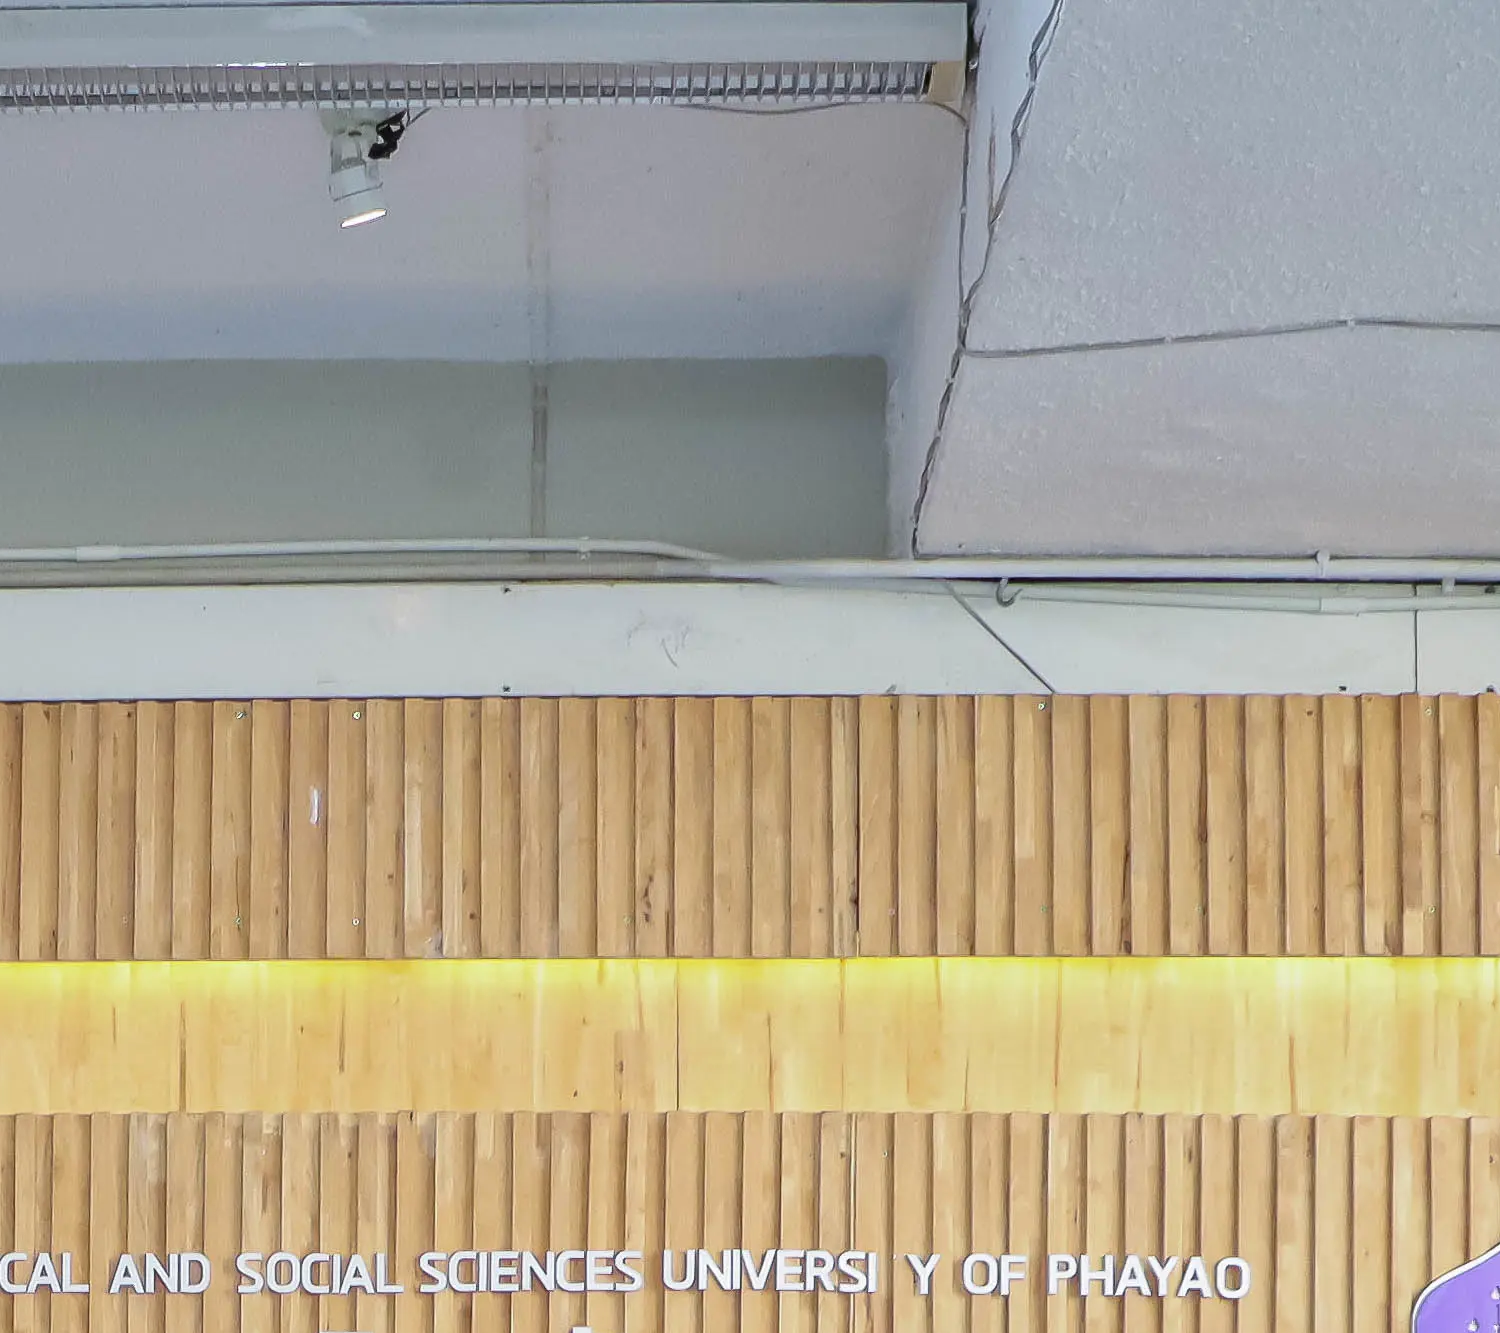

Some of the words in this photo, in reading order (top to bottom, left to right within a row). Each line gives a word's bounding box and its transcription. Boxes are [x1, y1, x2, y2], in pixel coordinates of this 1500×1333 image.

[109, 1251, 211, 1295] AND
[236, 1251, 404, 1295] SOCIAL
[419, 1249, 643, 1295] SCIENCES
[961, 1252, 1028, 1296] OF
[1046, 1253, 1253, 1300] PHAYAO
